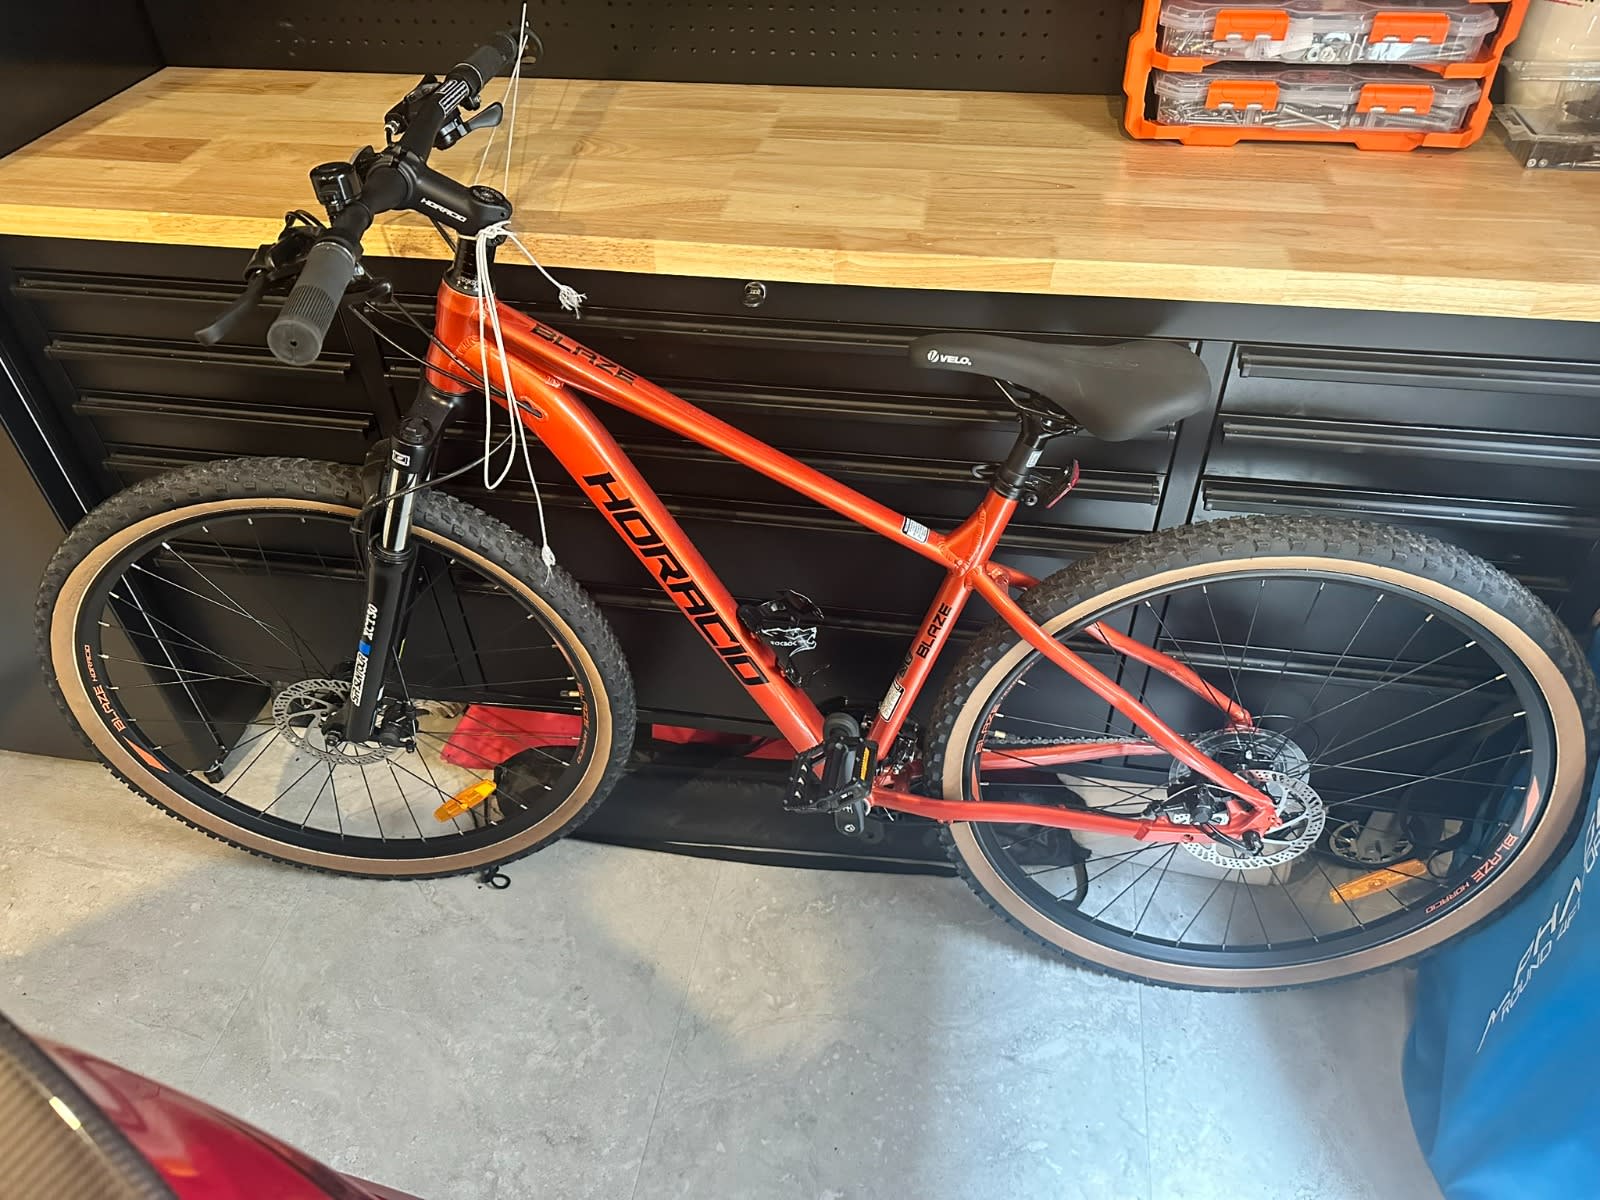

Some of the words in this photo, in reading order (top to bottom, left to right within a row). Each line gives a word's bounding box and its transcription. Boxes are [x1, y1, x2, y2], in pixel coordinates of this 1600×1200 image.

[530, 323, 638, 386] BLAZE
[583, 472, 770, 686] HORACIO
[916, 602, 952, 659] BLAZE
[92, 684, 127, 732] BLAZE
[1471, 833, 1519, 883] BLAZE
[1425, 881, 1470, 914] HORACIO
